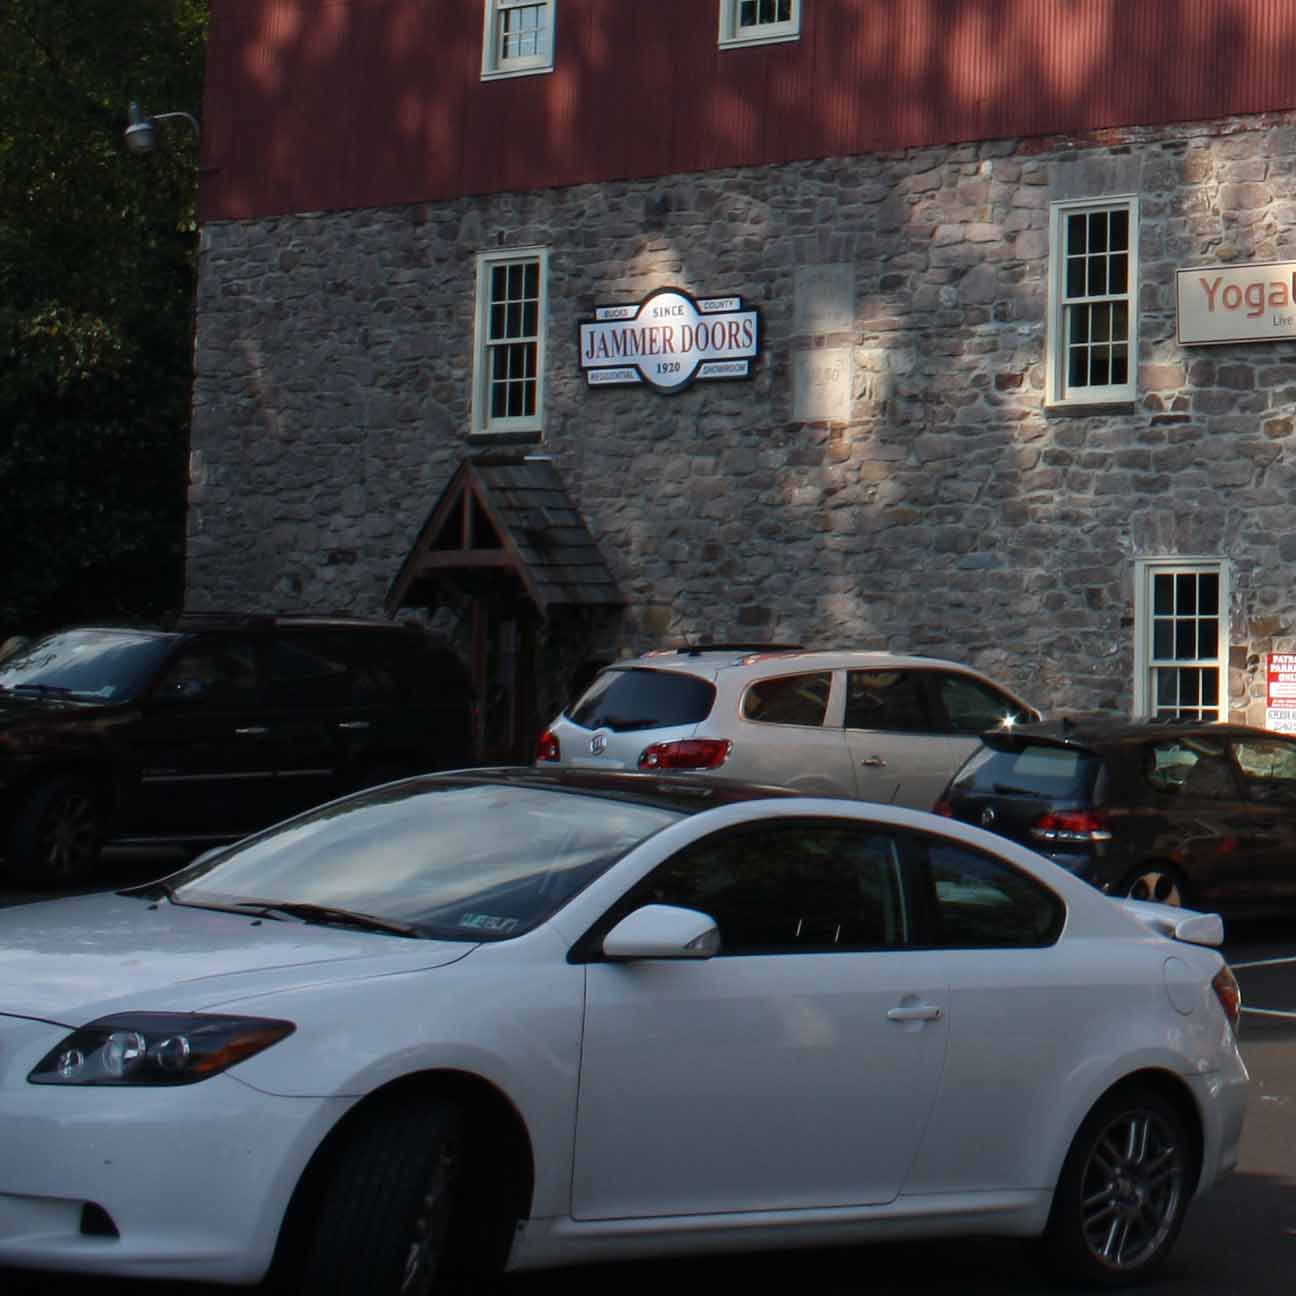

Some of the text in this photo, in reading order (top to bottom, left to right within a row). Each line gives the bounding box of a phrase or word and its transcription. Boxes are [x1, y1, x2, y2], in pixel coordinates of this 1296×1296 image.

[604, 300, 734, 318] BUCKS COUNTY
[653, 305, 684, 317] SINCE
[1272, 313, 1291, 326] Live
[586, 319, 753, 359] JAMMER DOORS
[656, 361, 681, 374] 1920
[703, 363, 746, 374] SHOWROOM
